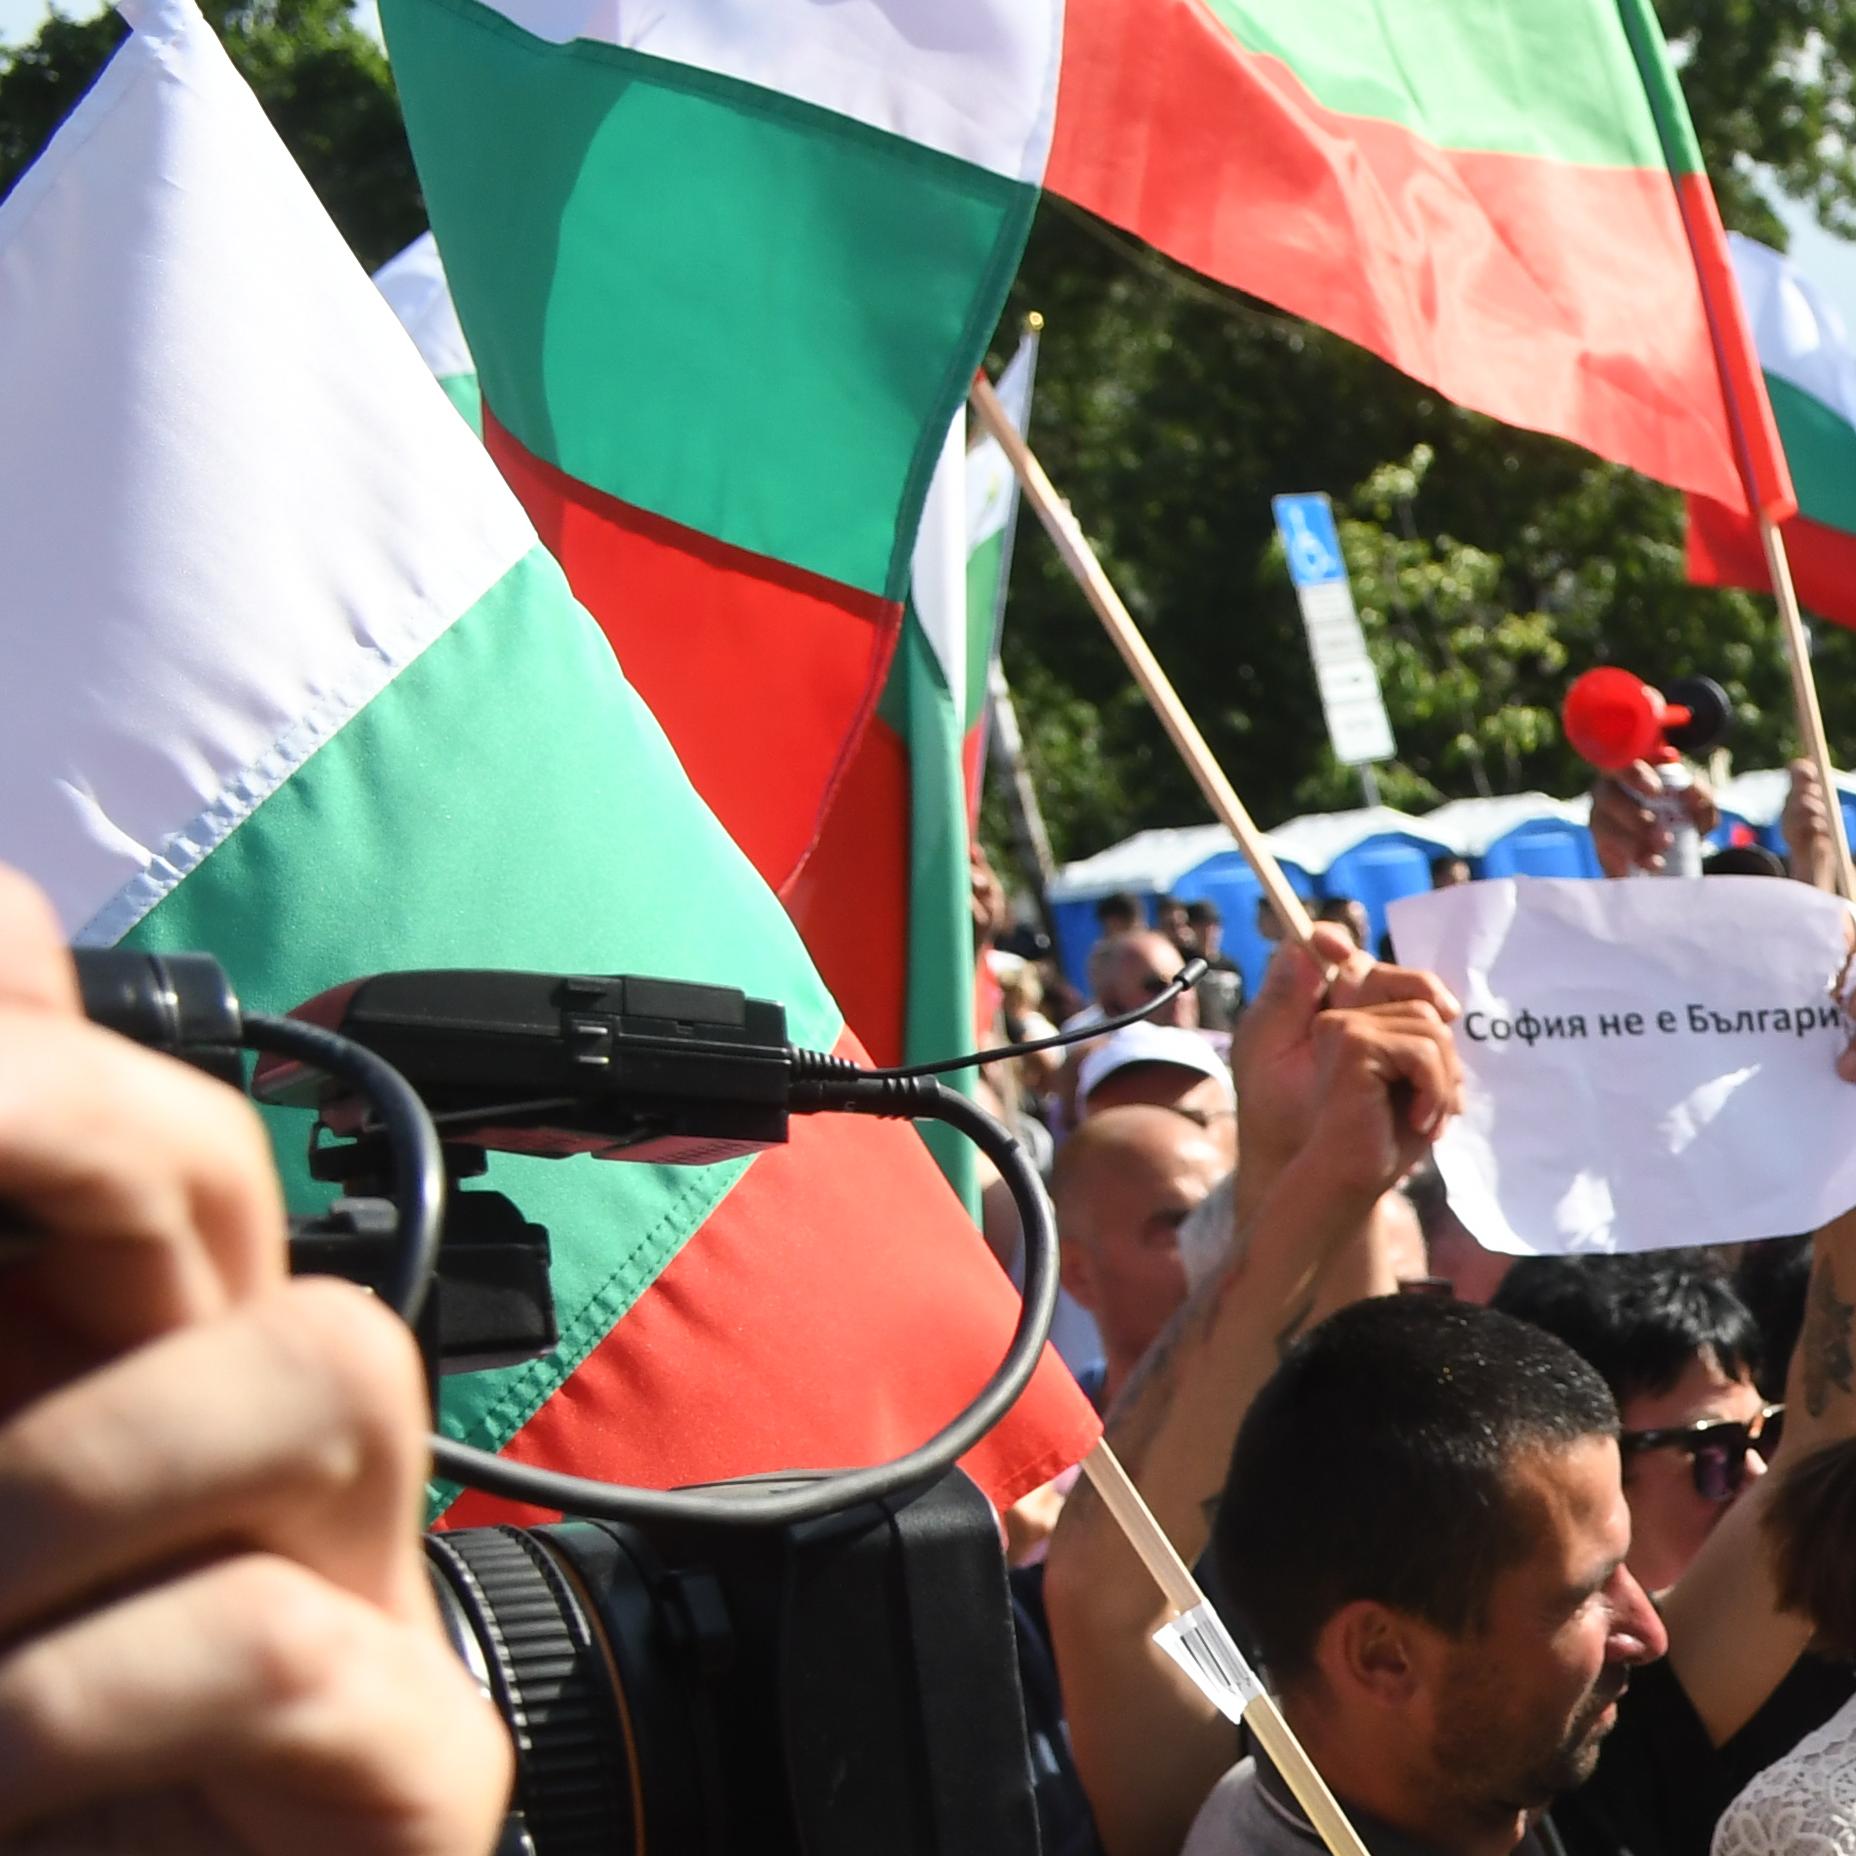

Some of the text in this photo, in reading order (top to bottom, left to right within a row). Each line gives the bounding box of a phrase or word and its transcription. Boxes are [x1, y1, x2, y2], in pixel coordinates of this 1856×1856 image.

[1464, 1003, 1842, 1045] София не е Българи
